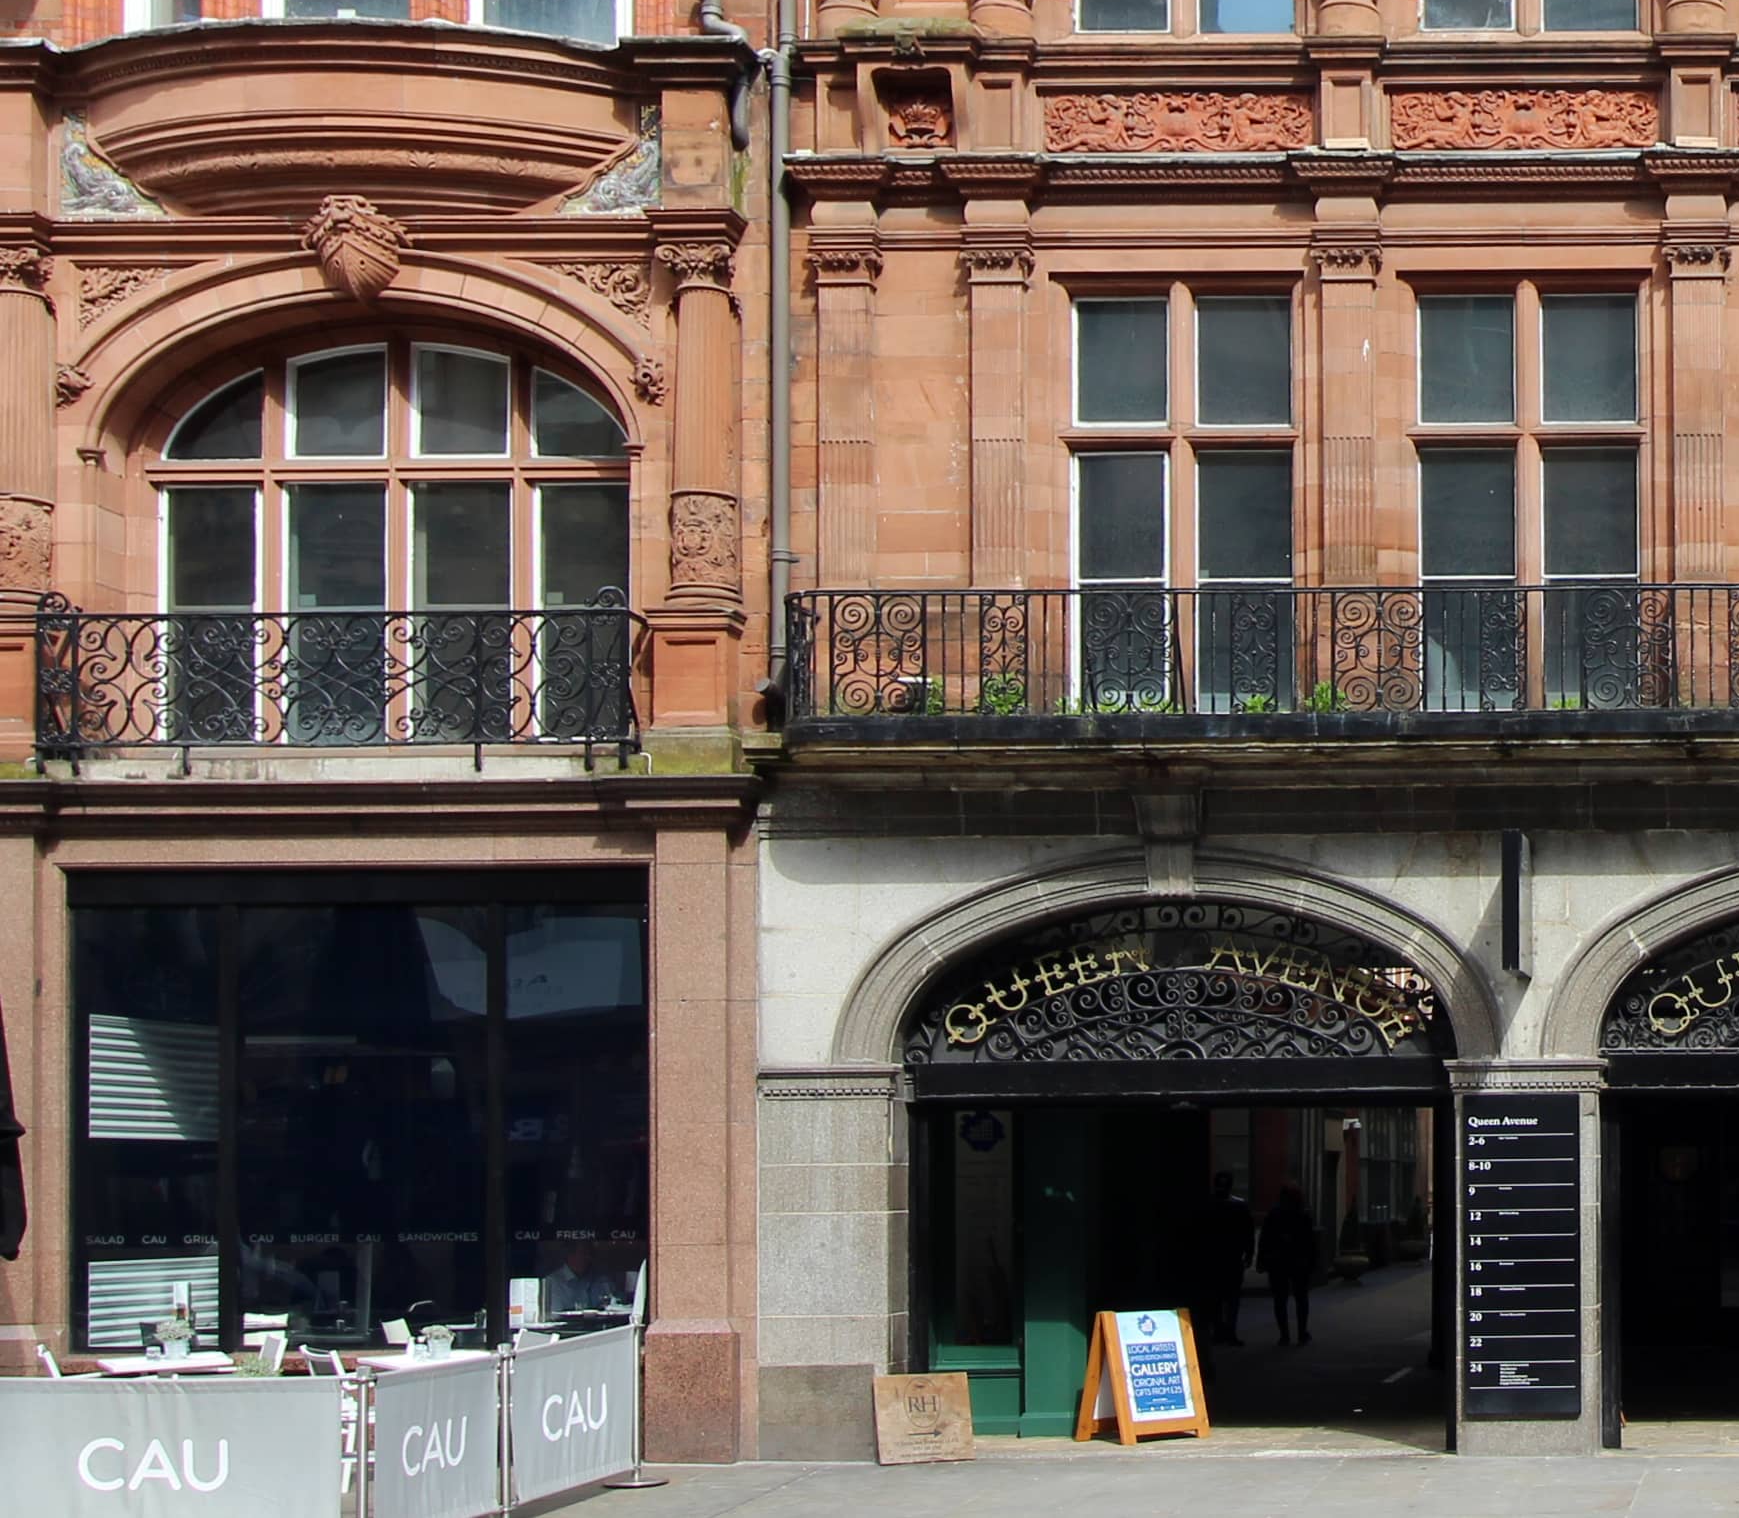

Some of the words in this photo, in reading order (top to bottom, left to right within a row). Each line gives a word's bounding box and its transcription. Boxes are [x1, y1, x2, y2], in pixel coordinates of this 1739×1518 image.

[945, 946, 1150, 1043] QUEEN
[1204, 936, 1426, 1048] AVENUE
[1468, 1116, 1500, 1127] Queen
[1502, 1116, 1538, 1125] Avenue
[1468, 1137, 1485, 1145] 2-6
[1468, 1162, 1491, 1170] 8-10
[1468, 1187, 1475, 1196] 9
[1470, 1212, 1481, 1221] 12
[85, 1235, 125, 1244] SALAD
[141, 1235, 167, 1244] CAU
[183, 1234, 218, 1244] GRILL
[249, 1233, 274, 1243] CAU
[290, 1233, 339, 1243] BURGER
[356, 1233, 381, 1243] CAU
[397, 1232, 478, 1242] SANDWICHES
[514, 1231, 540, 1240] CAU
[556, 1230, 595, 1240] FRESH
[611, 1229, 636, 1239] CAU
[1470, 1237, 1482, 1246] 14
[1470, 1262, 1482, 1271] 16
[1470, 1288, 1482, 1296] 18
[1469, 1313, 1482, 1321] 20
[1469, 1338, 1482, 1347] 22
[1128, 1345, 1151, 1354] LOCAL
[1131, 1362, 1178, 1376] GALLERY
[1469, 1364, 1482, 1372] 24
[908, 1396, 937, 1412] RH
[542, 1381, 608, 1442] CAU
[401, 1415, 469, 1477] CAU
[78, 1437, 230, 1491] CAU
